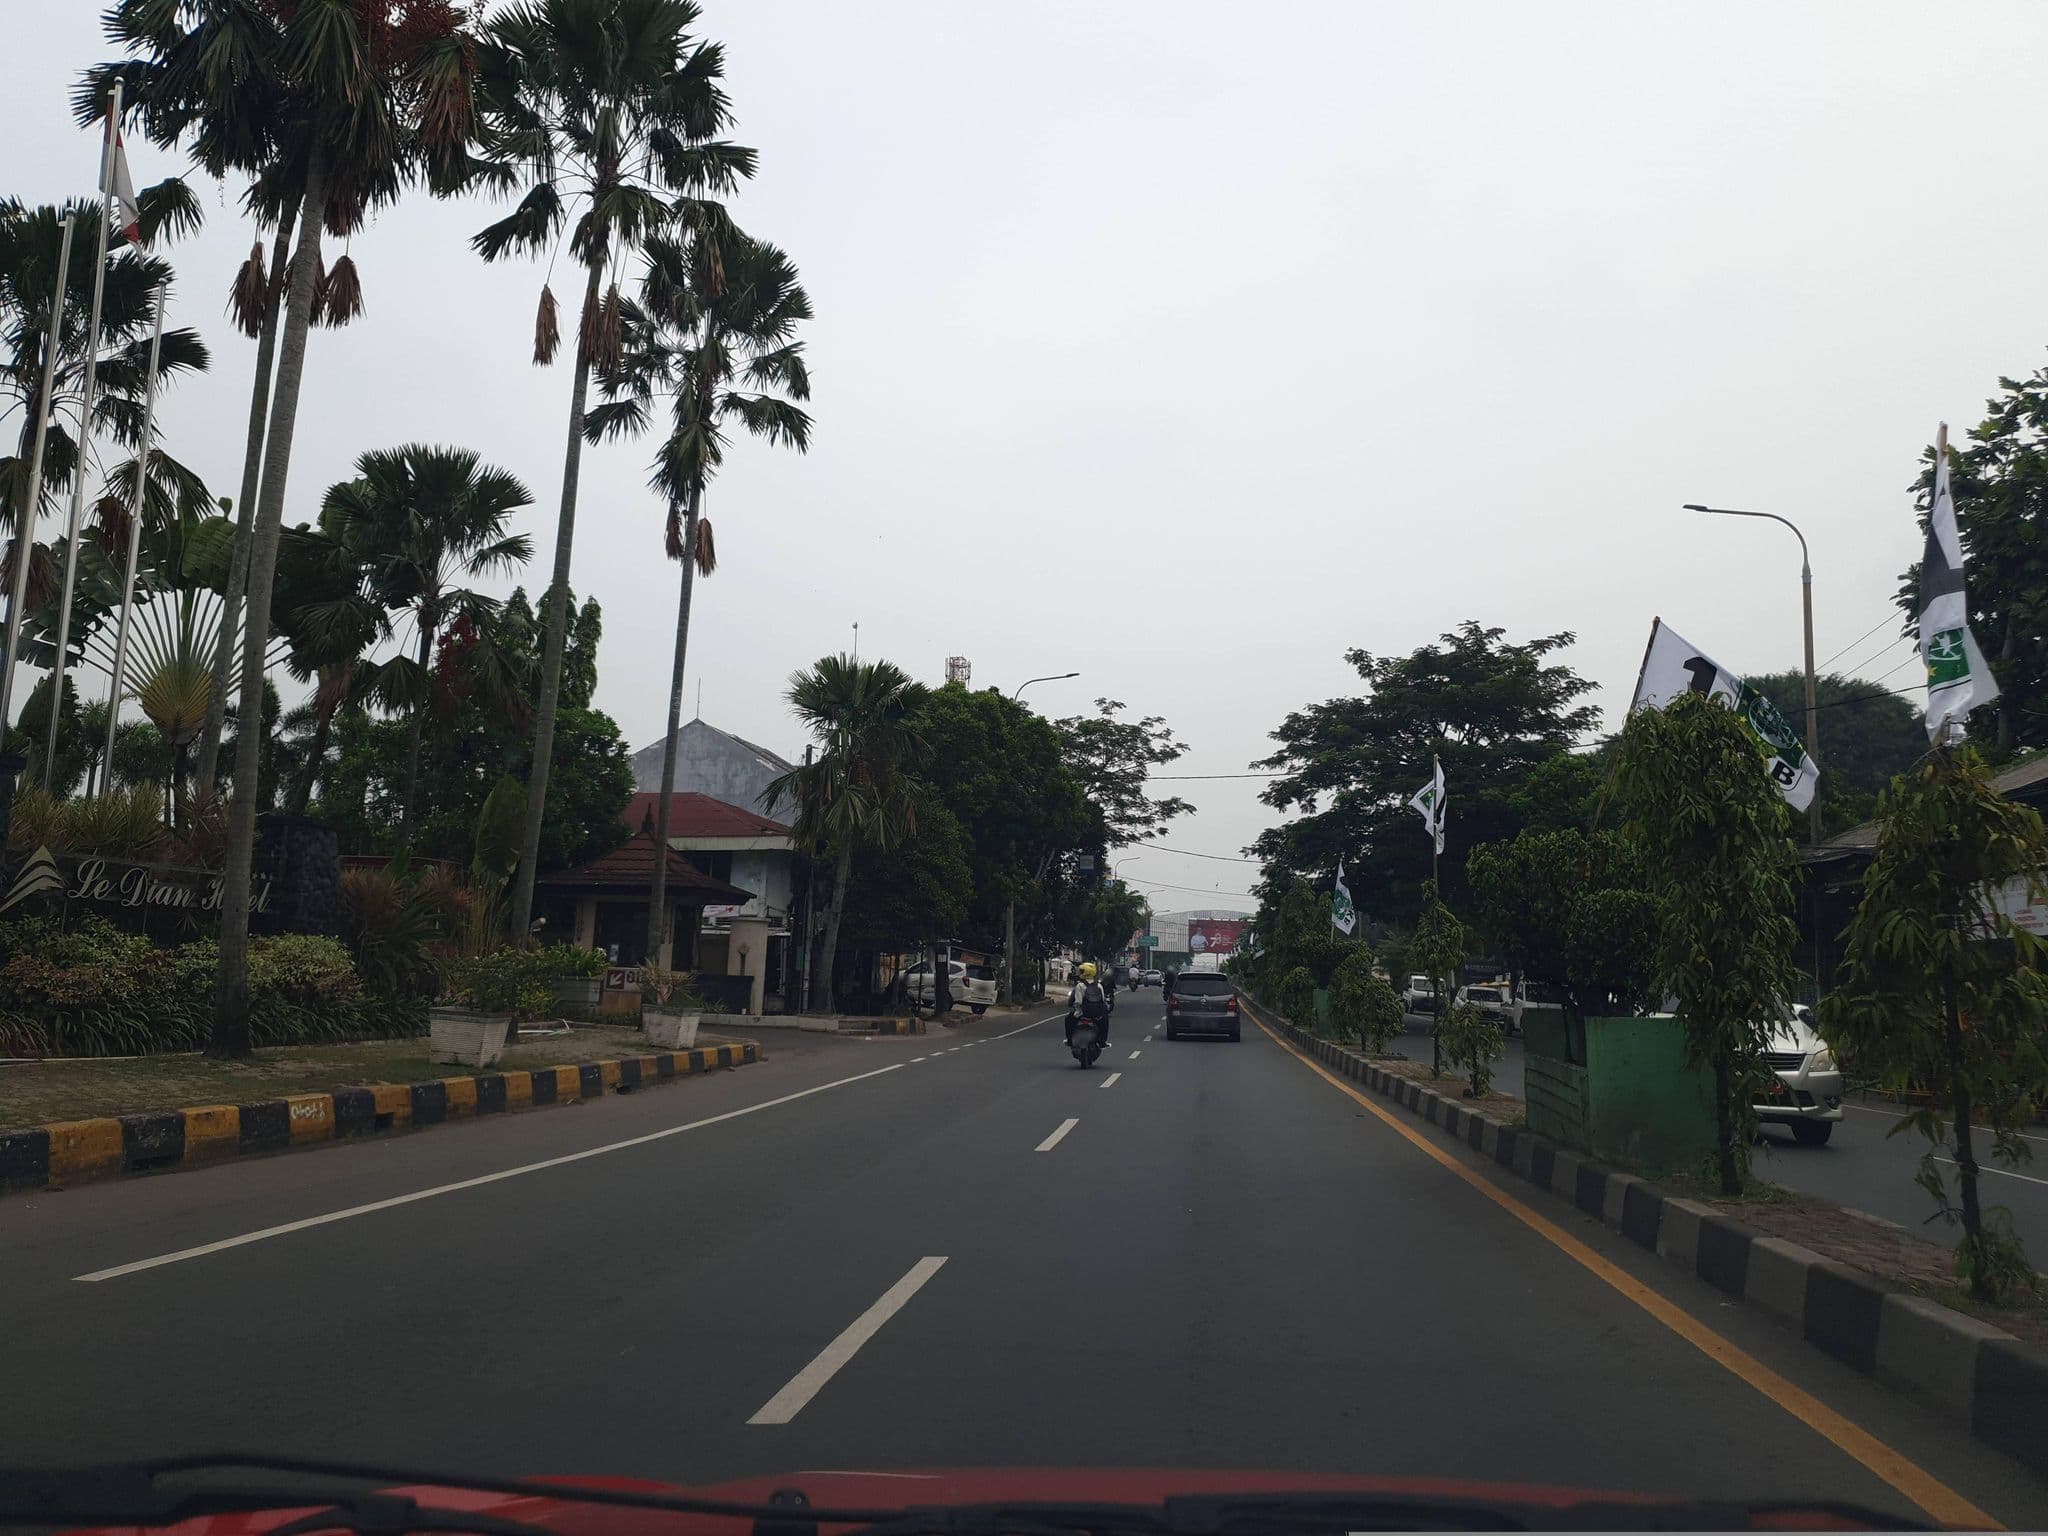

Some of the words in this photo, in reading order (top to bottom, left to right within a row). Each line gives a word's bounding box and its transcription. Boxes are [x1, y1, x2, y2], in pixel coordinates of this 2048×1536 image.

[67, 858, 116, 899] Le
[120, 867, 195, 908] Dian
[201, 876, 272, 914] Hel
